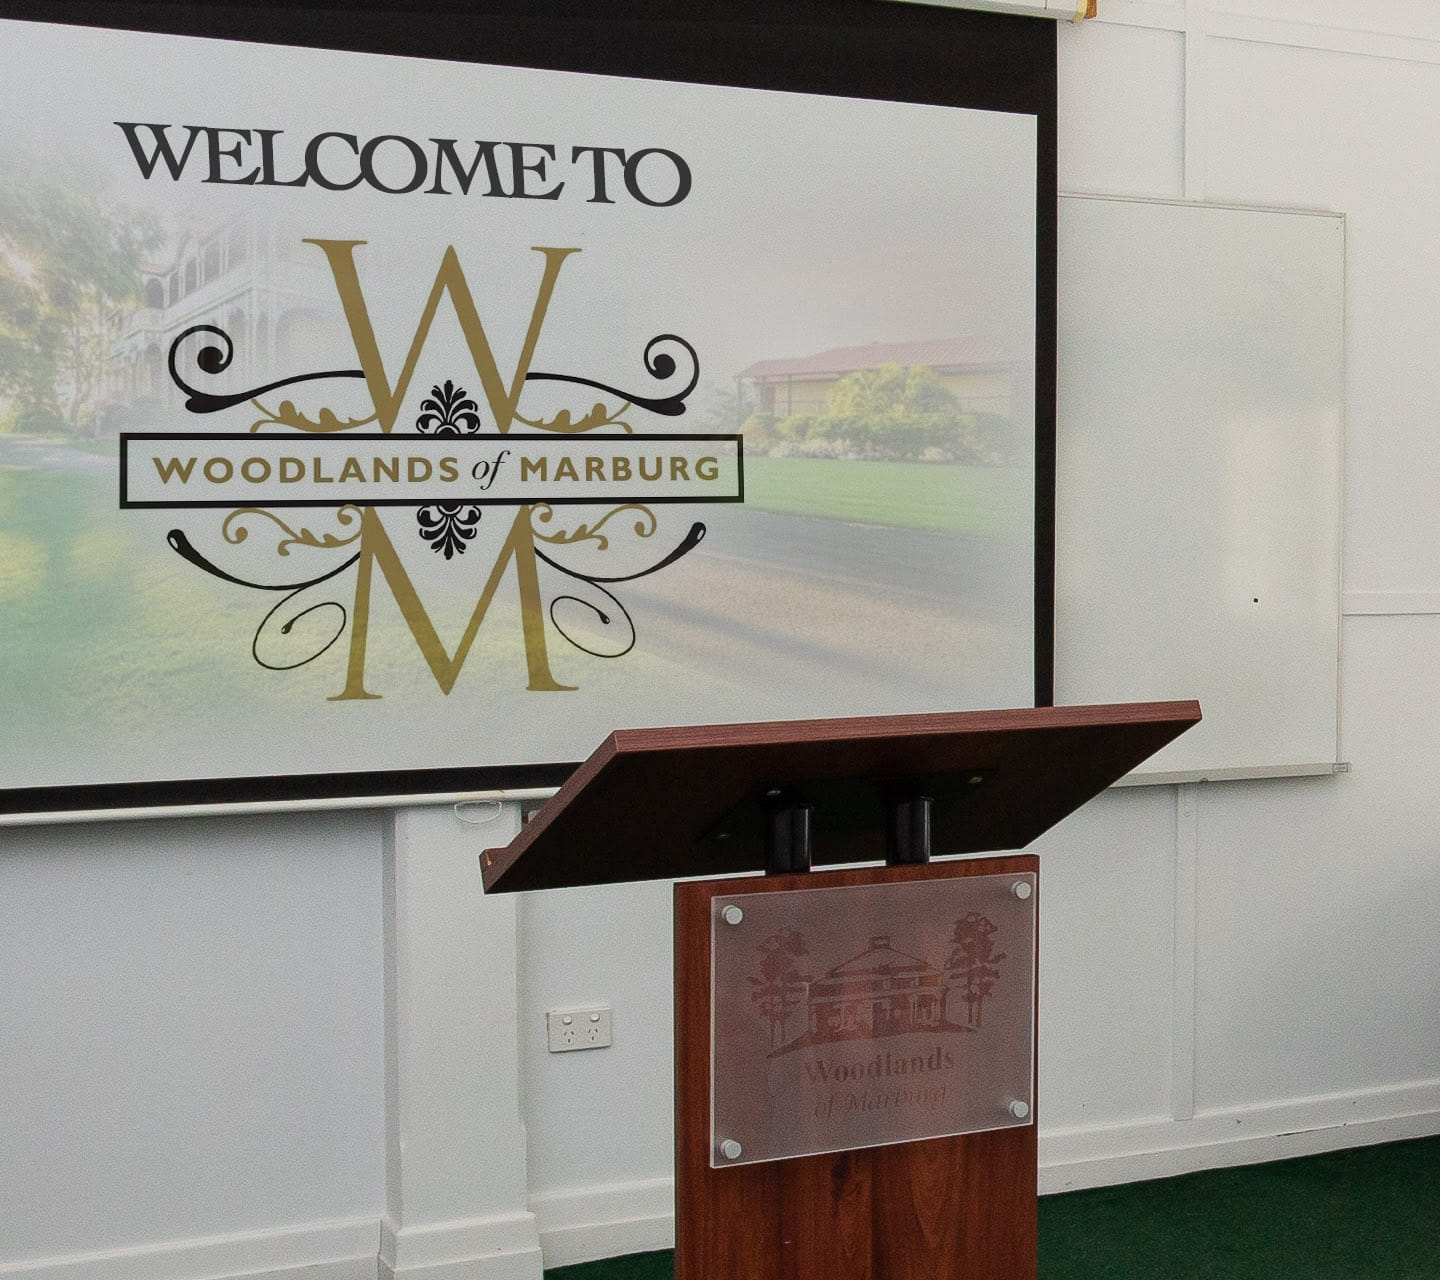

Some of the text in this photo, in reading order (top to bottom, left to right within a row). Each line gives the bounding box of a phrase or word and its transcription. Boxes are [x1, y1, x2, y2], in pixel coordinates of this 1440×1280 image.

[113, 121, 692, 207] WELCOME TO
[302, 238, 582, 434] W
[153, 450, 719, 491] WOODLANDS of MARBURG
[326, 505, 579, 701] M
[803, 1046, 955, 1083] Woodlands
